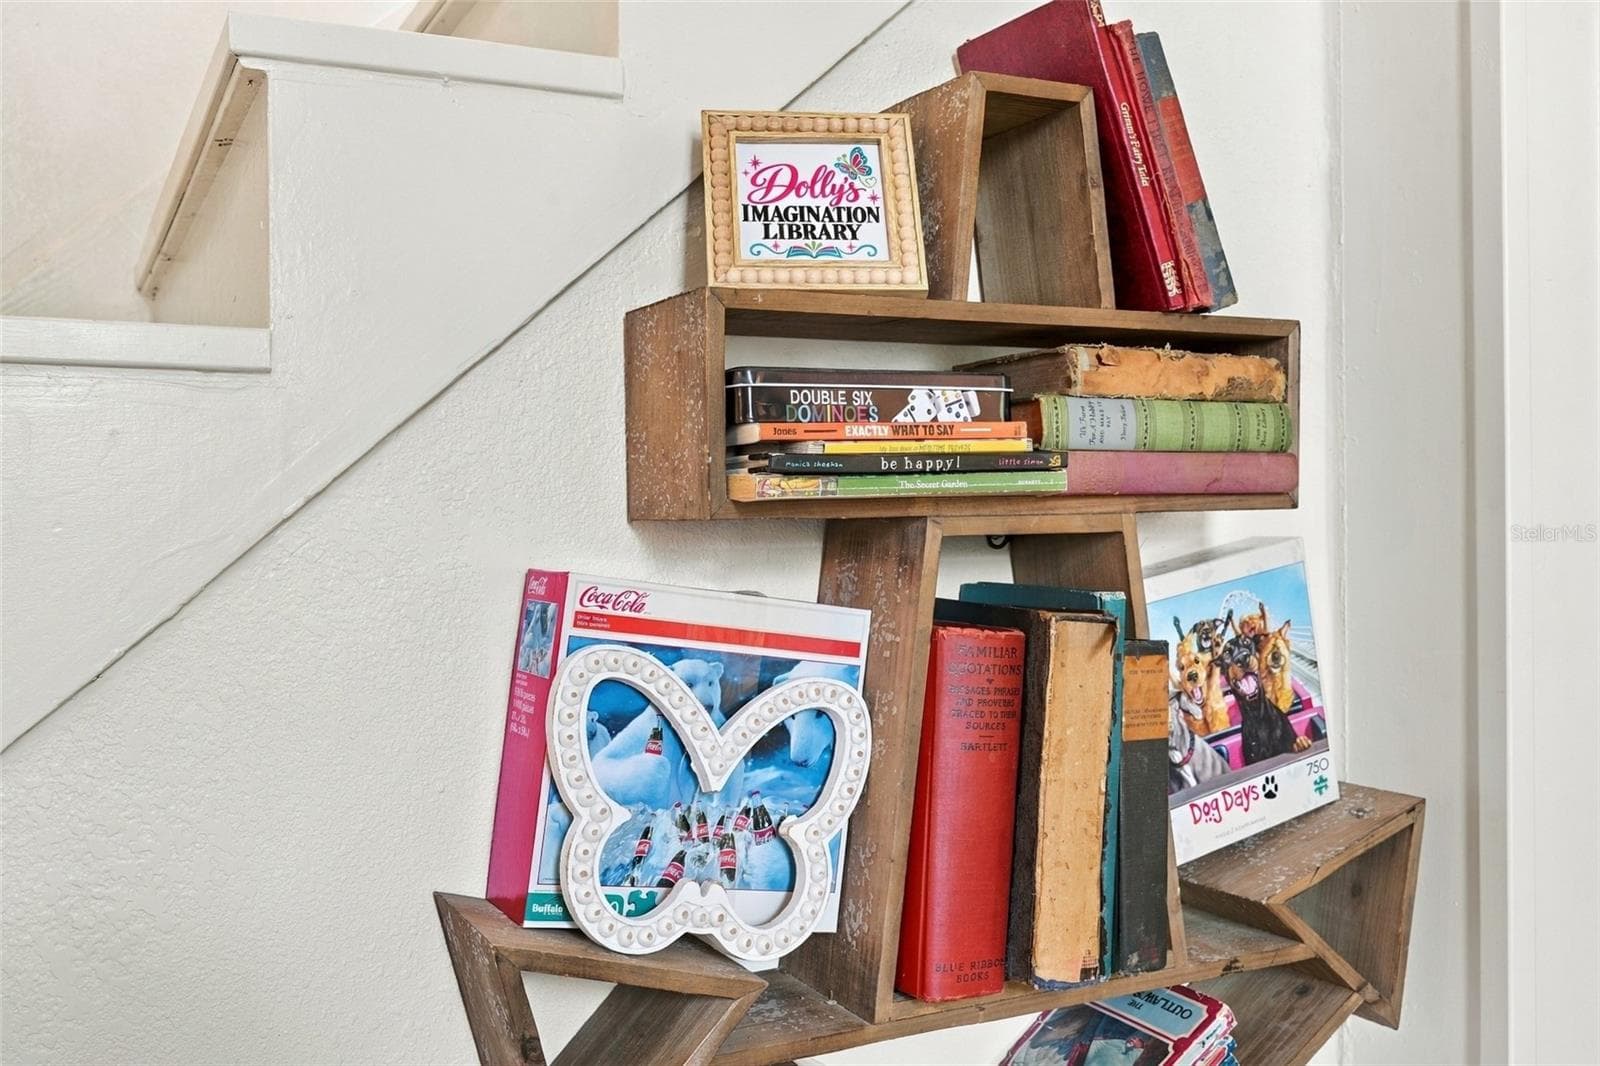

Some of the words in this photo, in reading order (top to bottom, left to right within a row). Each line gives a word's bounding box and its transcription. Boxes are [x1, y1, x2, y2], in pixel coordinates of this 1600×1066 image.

[1120, 102, 1137, 139] Grimm's
[1131, 140, 1143, 164] Fairy
[747, 163, 867, 208] Dolly's
[741, 203, 881, 224] IMAGINATION
[762, 223, 863, 241] LIBRARY
[789, 389, 847, 404] DOUBLE
[852, 390, 873, 405] SIX
[785, 404, 879, 423] DOMINOES
[773, 427, 797, 436] Jones
[844, 424, 889, 437] EXACTLY
[891, 424, 920, 436] WHAT
[921, 424, 935, 436] TO
[937, 424, 955, 436] SAY
[880, 457, 898, 470] be
[904, 456, 961, 471] happy!
[899, 480, 916, 489] The
[916, 480, 941, 489] Secret
[941, 479, 969, 489] Garden
[956, 644, 1018, 659] FAMILIAR
[948, 662, 1022, 677] QUOTATIONS
[988, 710, 999, 719] TO
[965, 721, 1006, 731] SOURCES
[960, 742, 1009, 752] BARTLETT
[1306, 757, 1330, 776] 750
[1189, 797, 1223, 825] Dog
[1221, 784, 1260, 813] Days
[532, 903, 563, 914] Buffalo
[935, 961, 965, 973] BLUE
[956, 970, 990, 984] BOOKS
[1127, 999, 1144, 1010] THE
